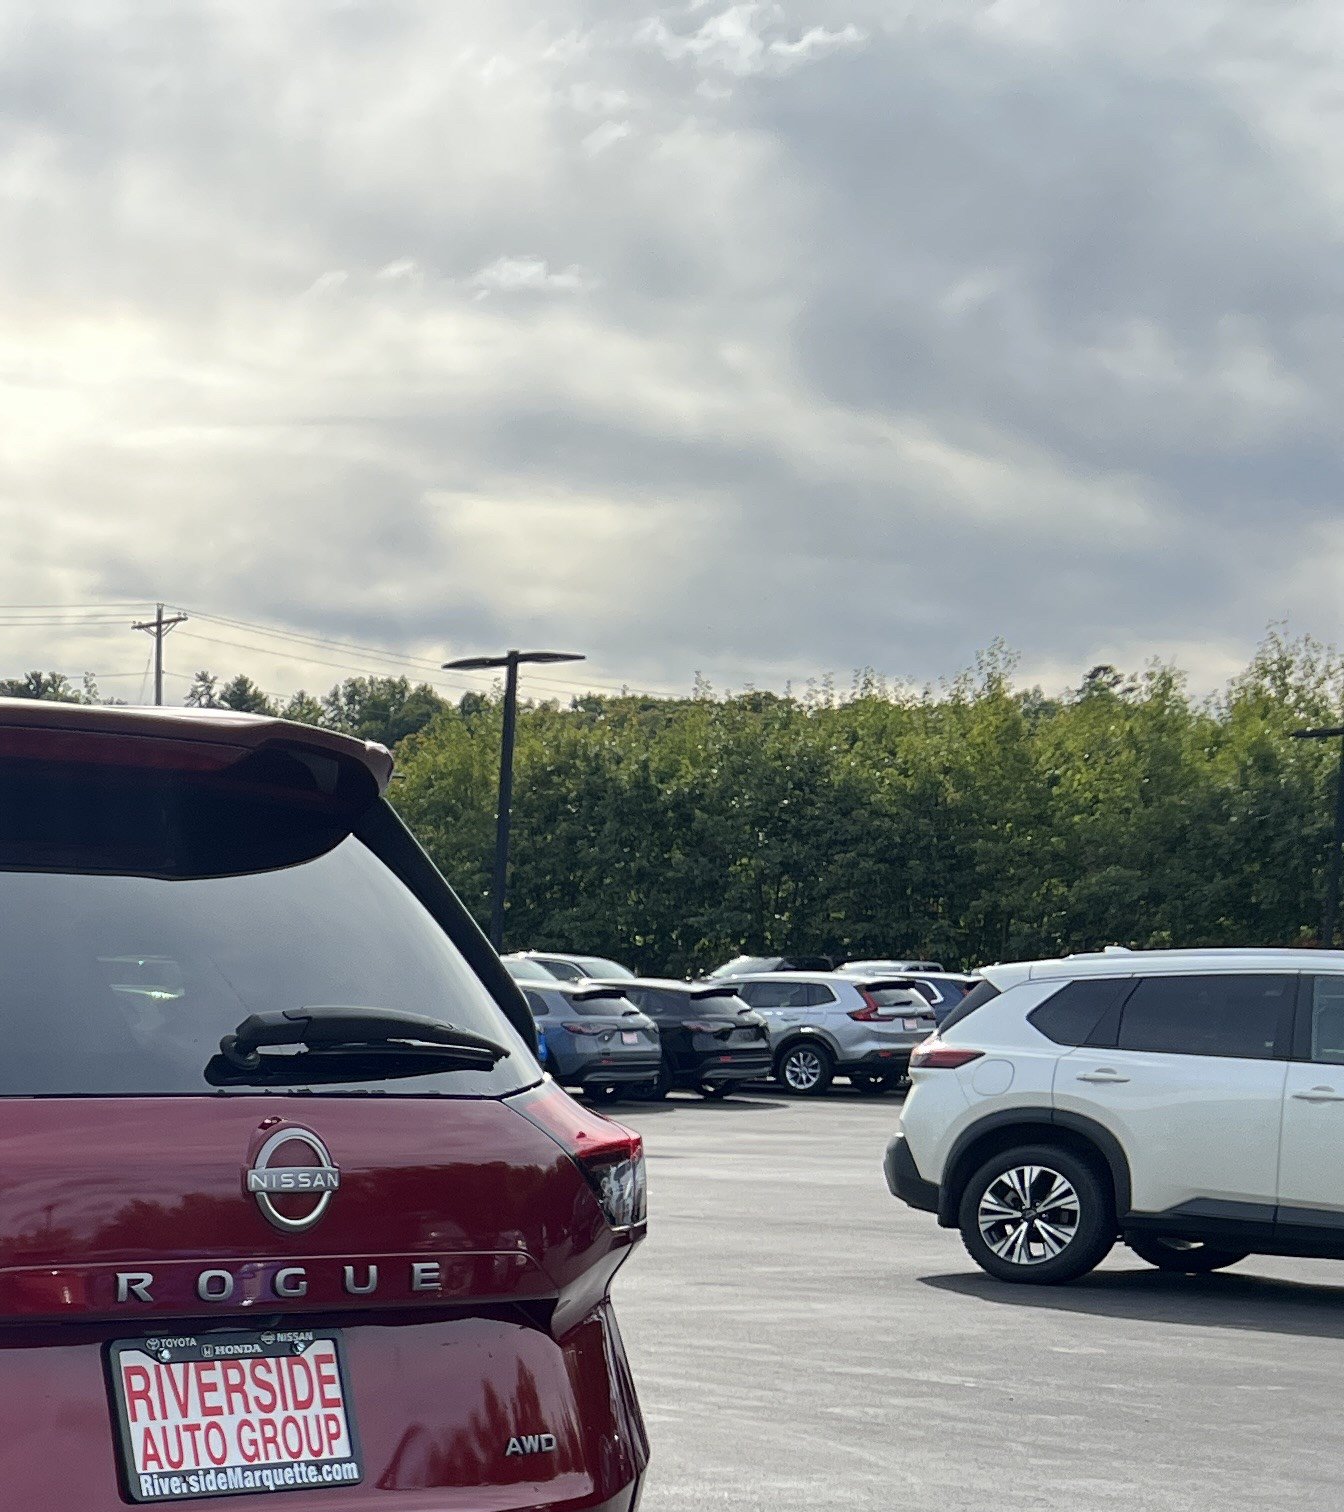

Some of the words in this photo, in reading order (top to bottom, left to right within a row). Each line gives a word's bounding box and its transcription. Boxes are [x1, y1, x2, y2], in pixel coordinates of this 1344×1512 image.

[250, 1172, 340, 1189] NISSAN
[116, 1261, 442, 1302] ROGUE
[160, 1337, 197, 1348] TOYOTA
[276, 1331, 313, 1342] NISSAN
[214, 1344, 263, 1355] HONDA
[123, 1353, 342, 1422] RIVERSIDE
[141, 1421, 227, 1471] AUTO
[236, 1413, 342, 1463] GROUP
[505, 1433, 557, 1457] AWD
